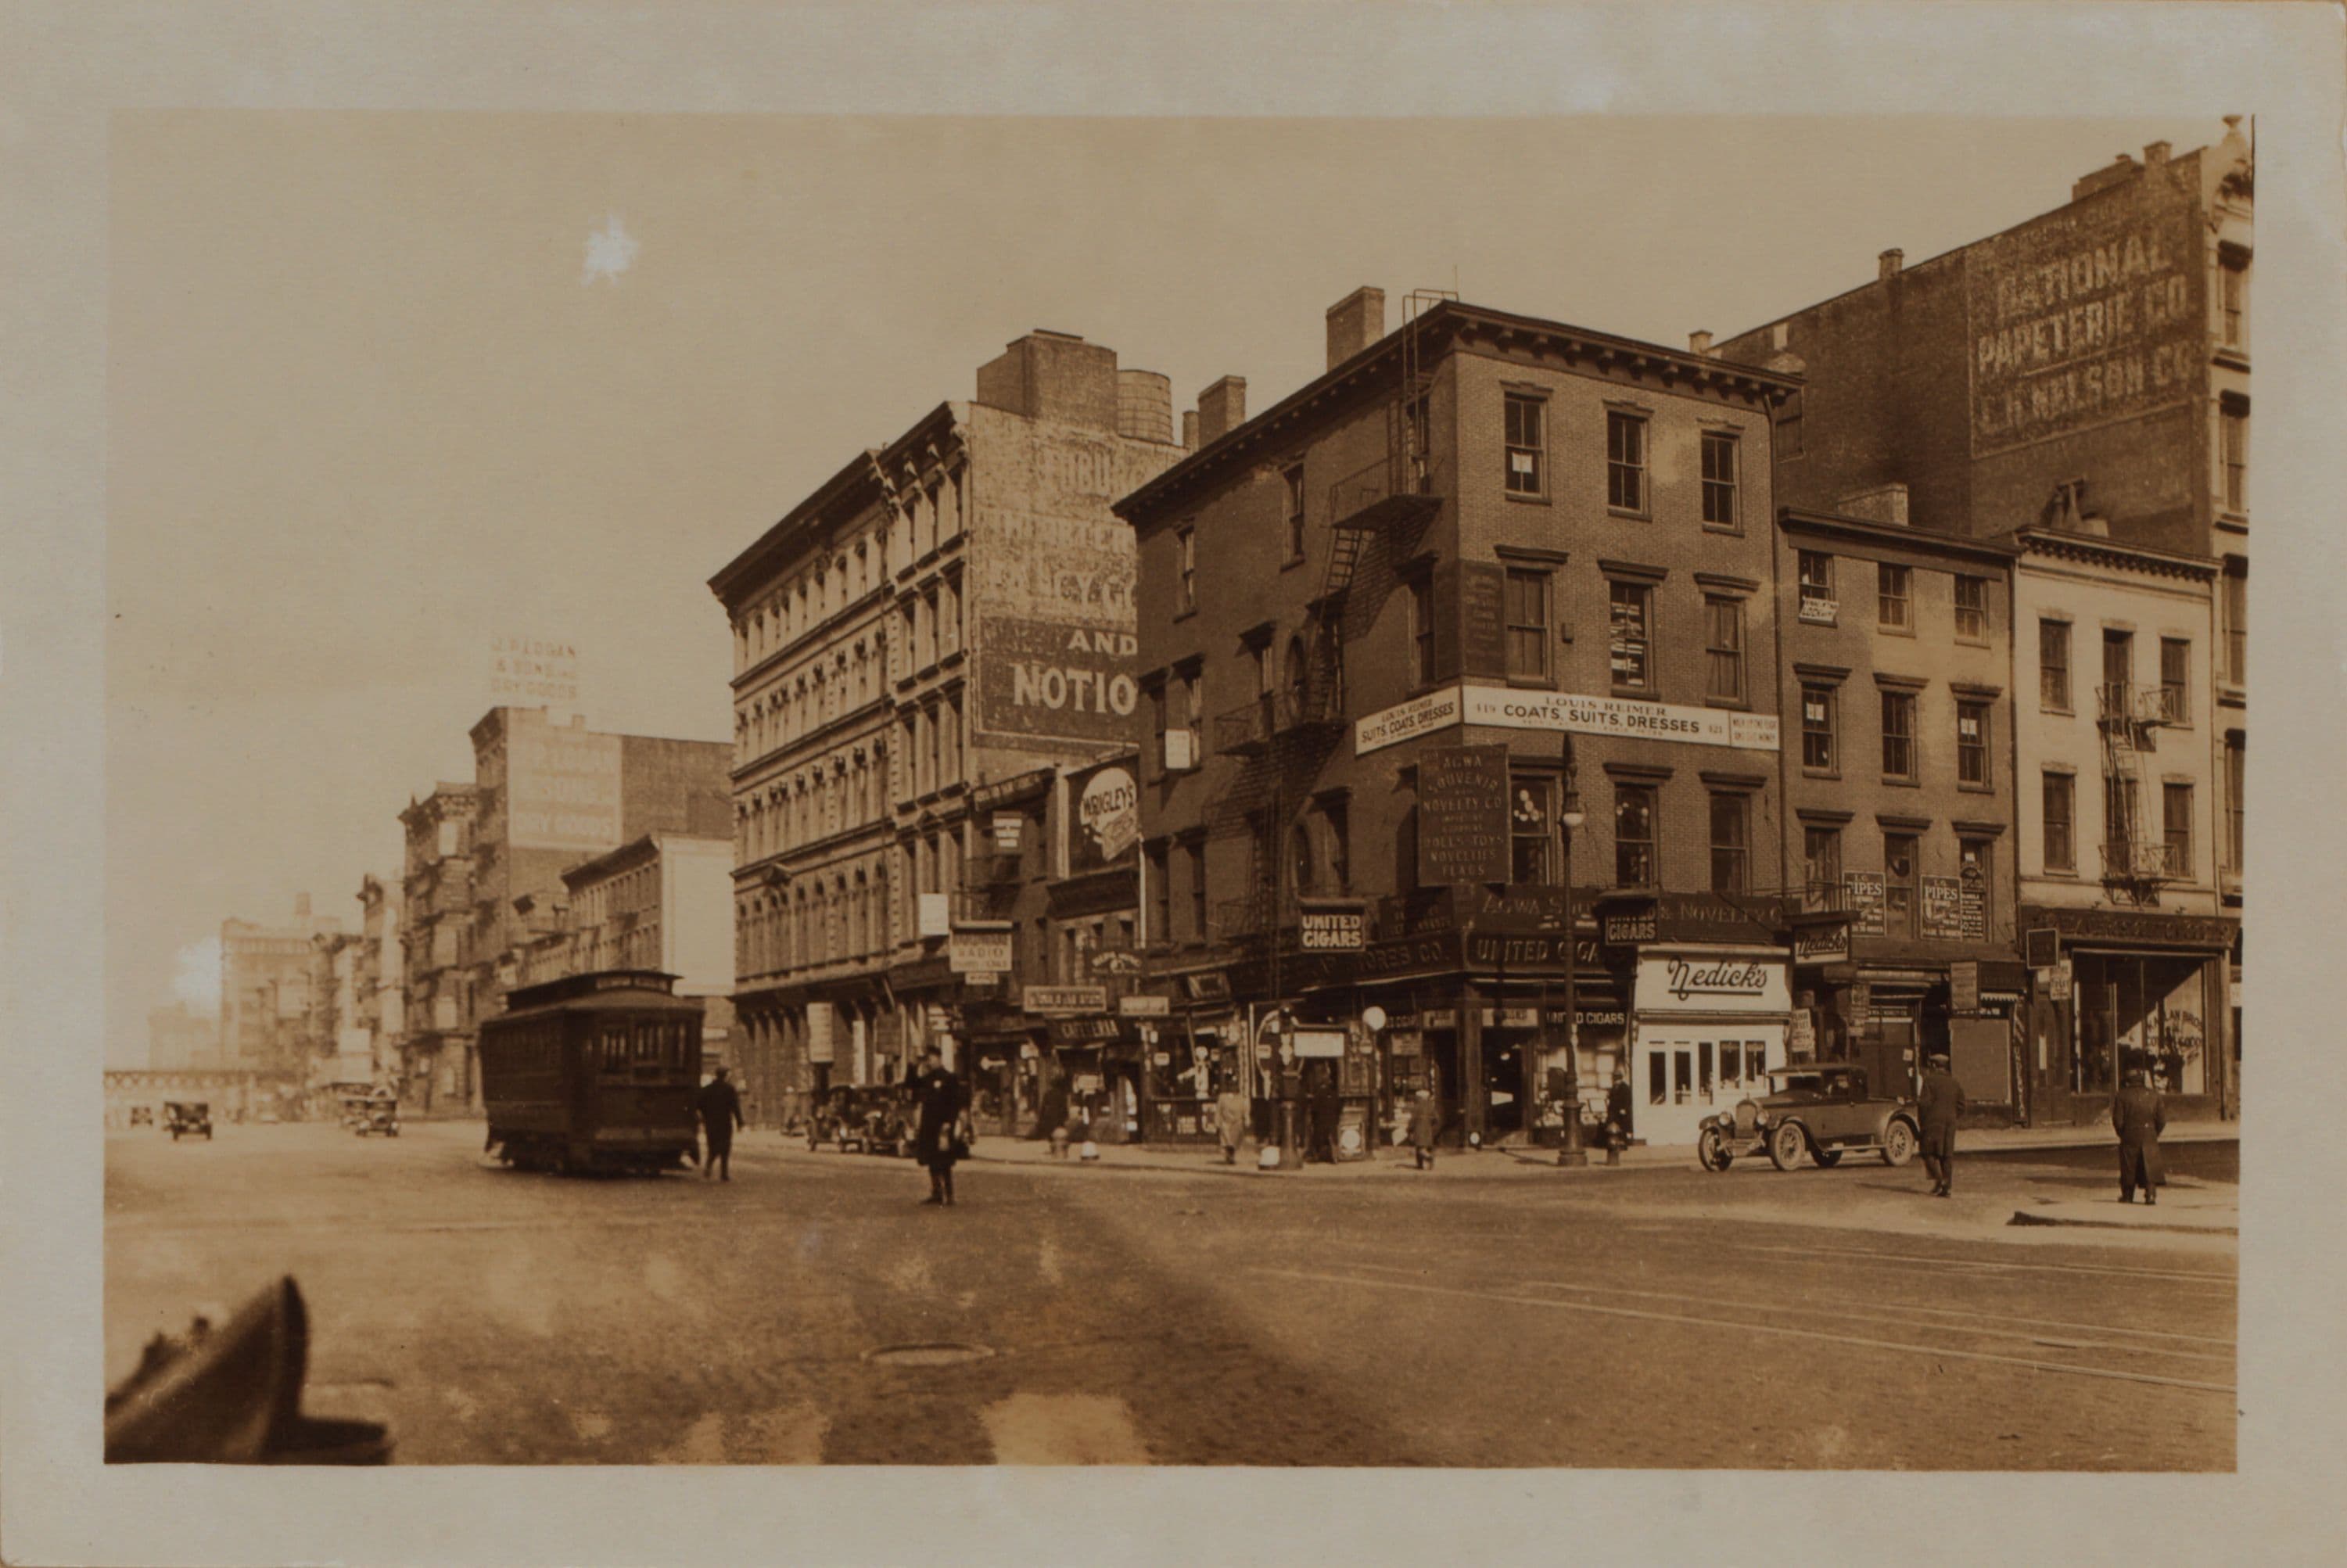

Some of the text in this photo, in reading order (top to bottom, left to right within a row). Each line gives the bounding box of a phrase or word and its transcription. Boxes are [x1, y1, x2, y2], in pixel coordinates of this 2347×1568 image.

[1067, 629, 1138, 655] AND
[1008, 660, 1137, 716] NOTIO
[1418, 701, 1455, 724] DRESSES
[1627, 716, 1700, 733] DRESSES
[1423, 797, 1479, 811] NOVELTY
[1846, 881, 1882, 895] PIPES
[1925, 885, 1958, 900] PIPES
[1301, 914, 1362, 929] UNITED
[1680, 902, 1765, 924] NOVELTY
[1301, 931, 1362, 947] CIGARS
[1608, 922, 1656, 939] CIGARS
[958, 947, 1004, 958] RADIO
[1477, 939, 1549, 962] UNITED
[1797, 931, 1847, 960] Nedick's
[1667, 955, 1767, 1001] Nedick's
[1586, 1012, 1625, 1024] CIGARS
